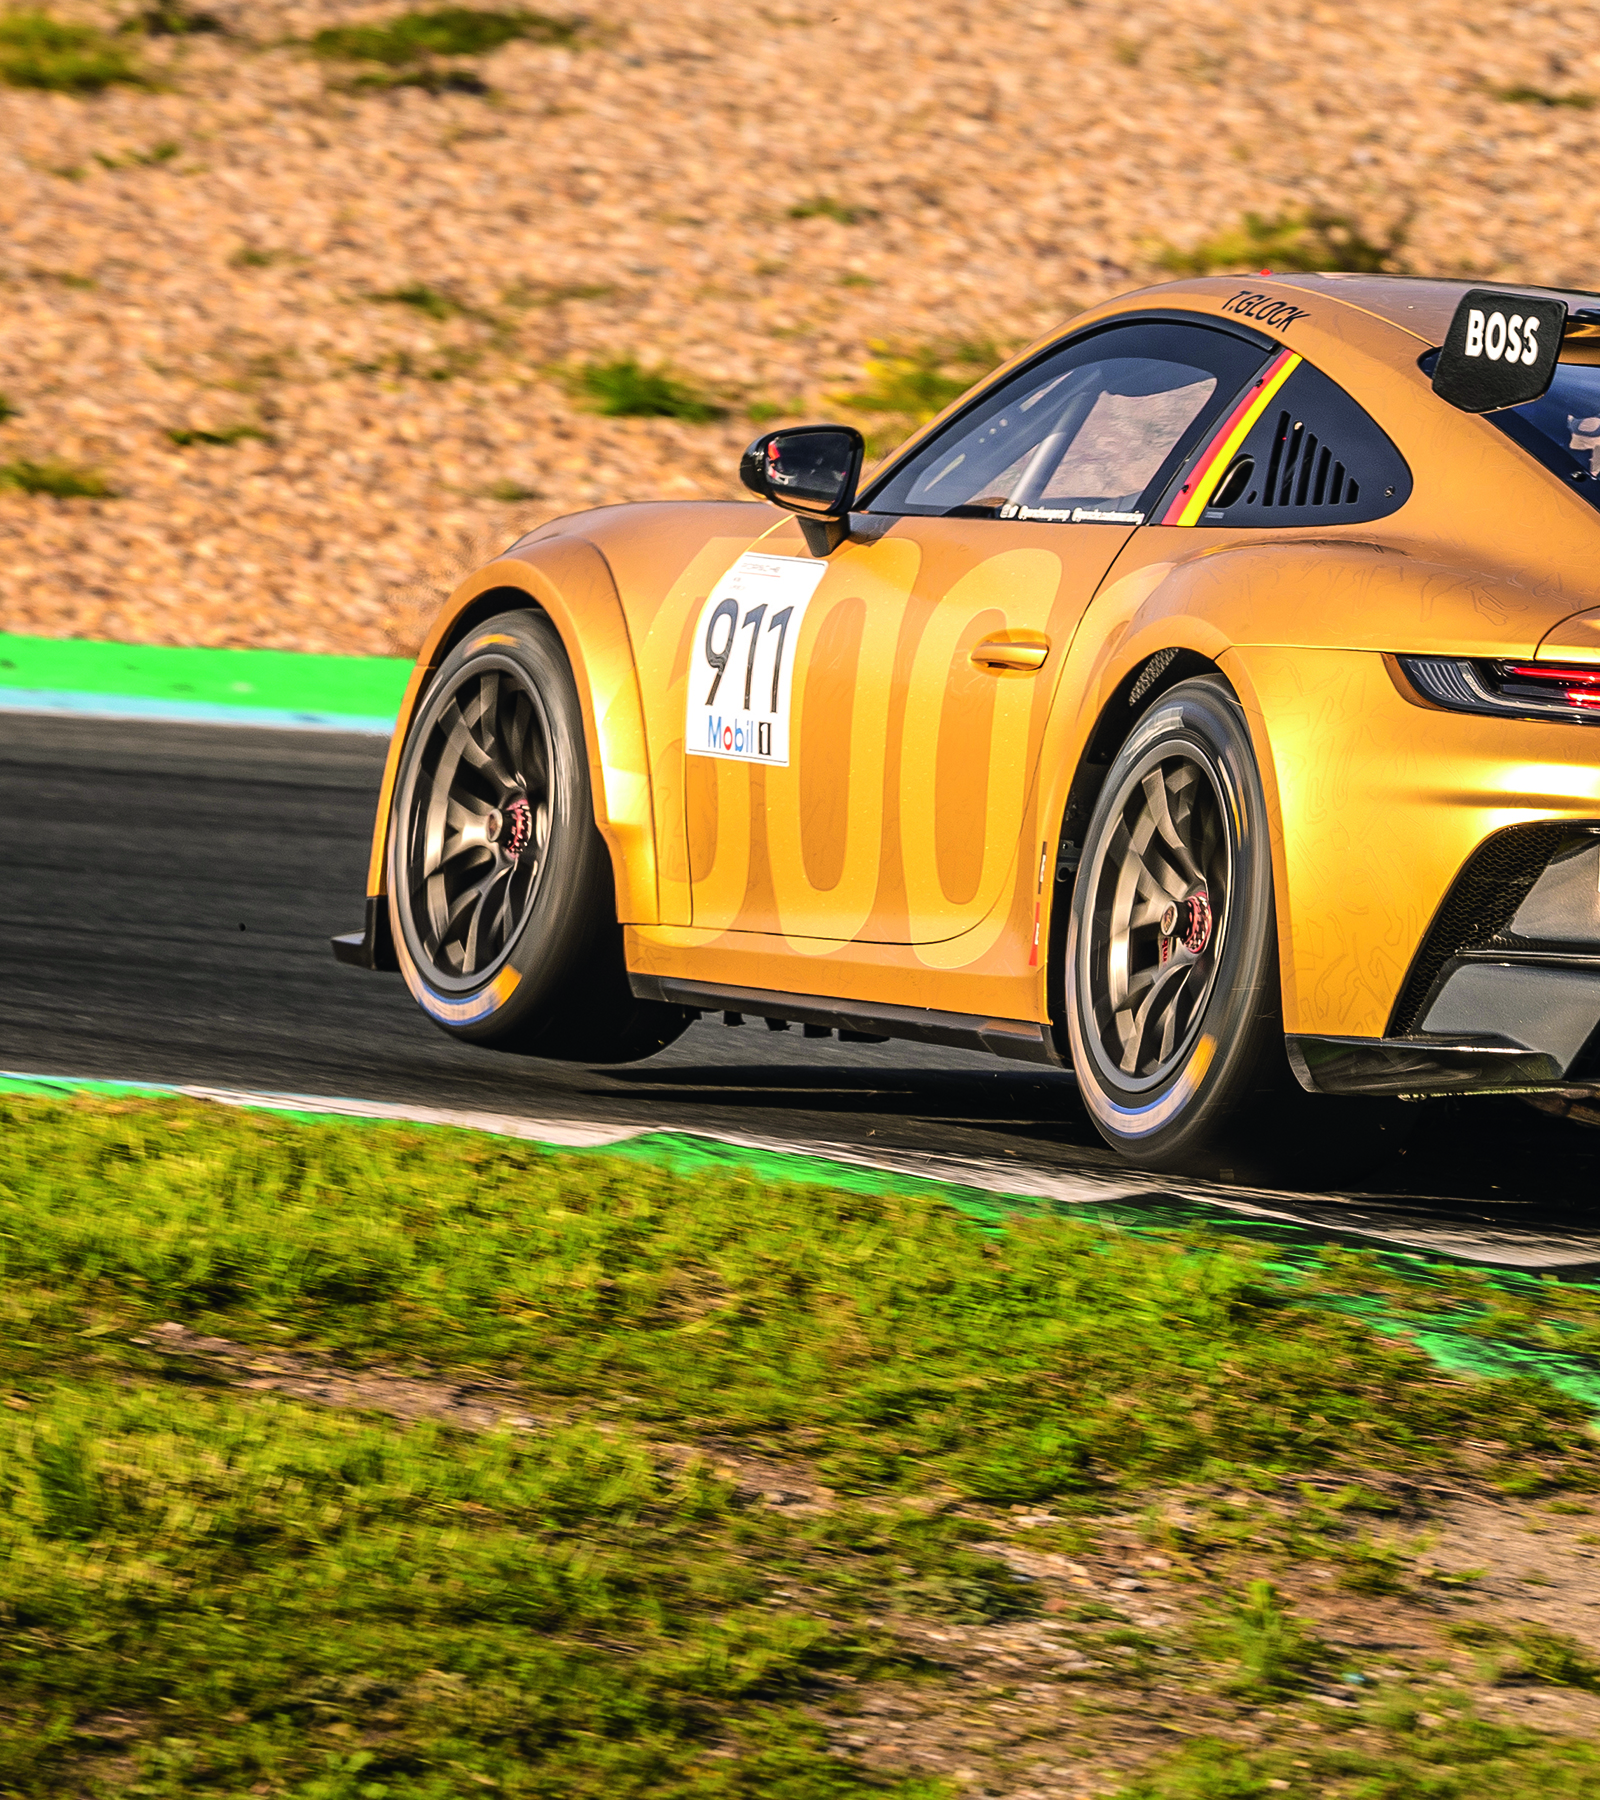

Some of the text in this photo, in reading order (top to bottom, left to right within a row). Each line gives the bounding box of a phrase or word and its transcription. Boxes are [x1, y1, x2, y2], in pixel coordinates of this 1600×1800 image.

[1221, 290, 1312, 333] T.GLOCK
[1464, 308, 1541, 366] BOSS
[705, 598, 795, 713] 911
[708, 715, 754, 753] Mobil
